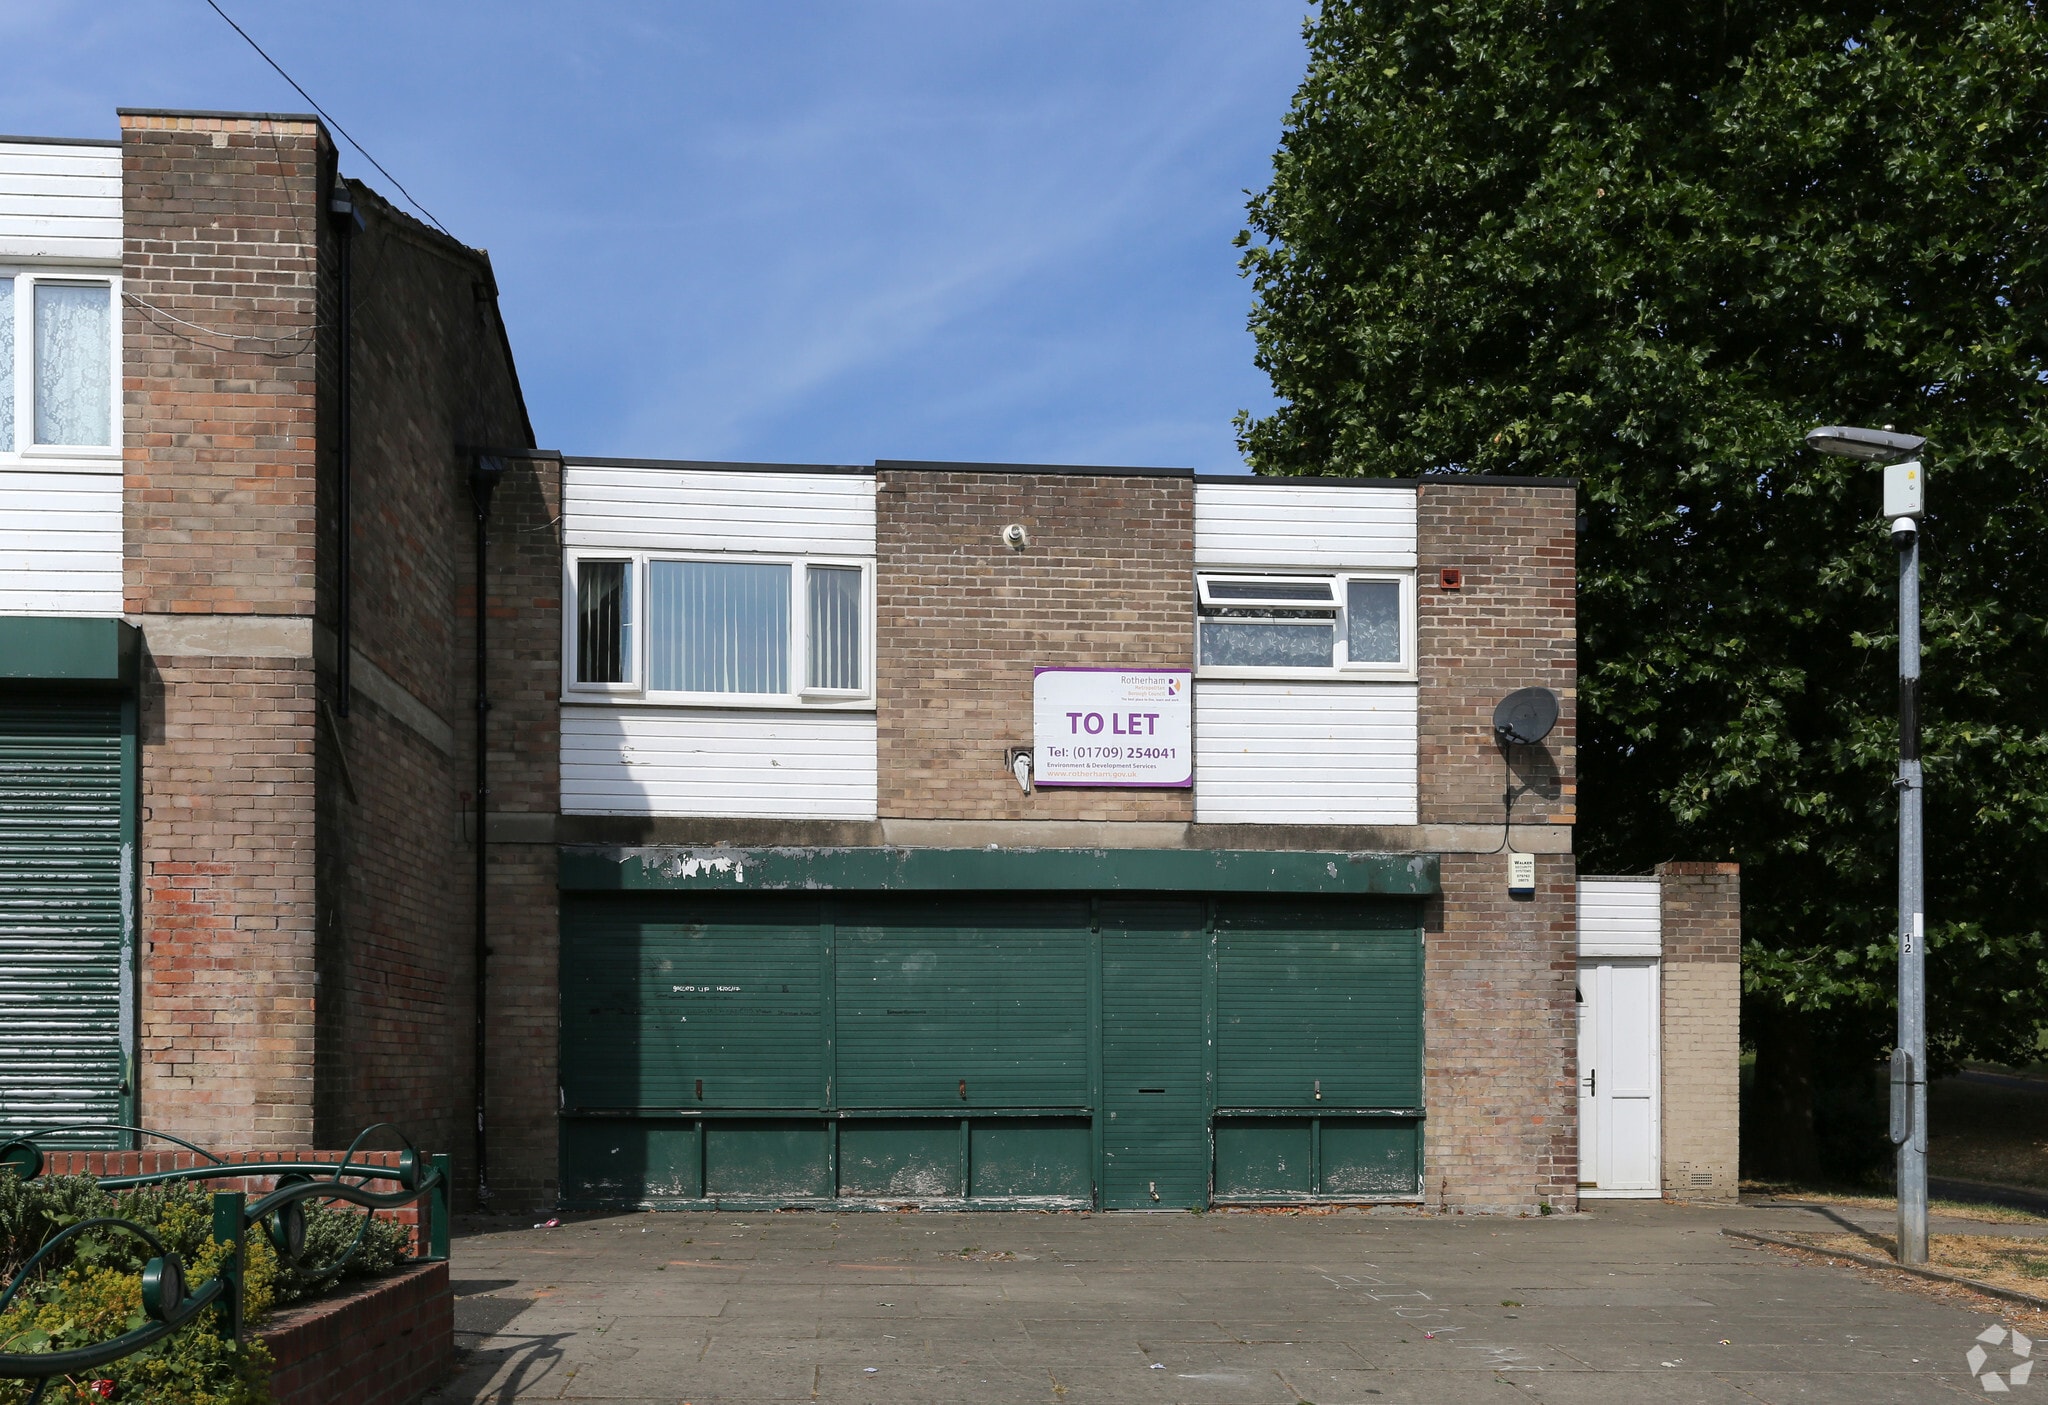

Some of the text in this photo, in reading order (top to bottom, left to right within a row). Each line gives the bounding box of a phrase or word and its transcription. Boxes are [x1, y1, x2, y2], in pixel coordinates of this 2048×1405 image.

[1121, 676, 1165, 685] Rotherham
[1066, 712, 1160, 735] TO LET
[1047, 746, 1176, 760] Tel: (01709) 254041
[1047, 771, 1137, 779] www.rotherham.gov.uk
